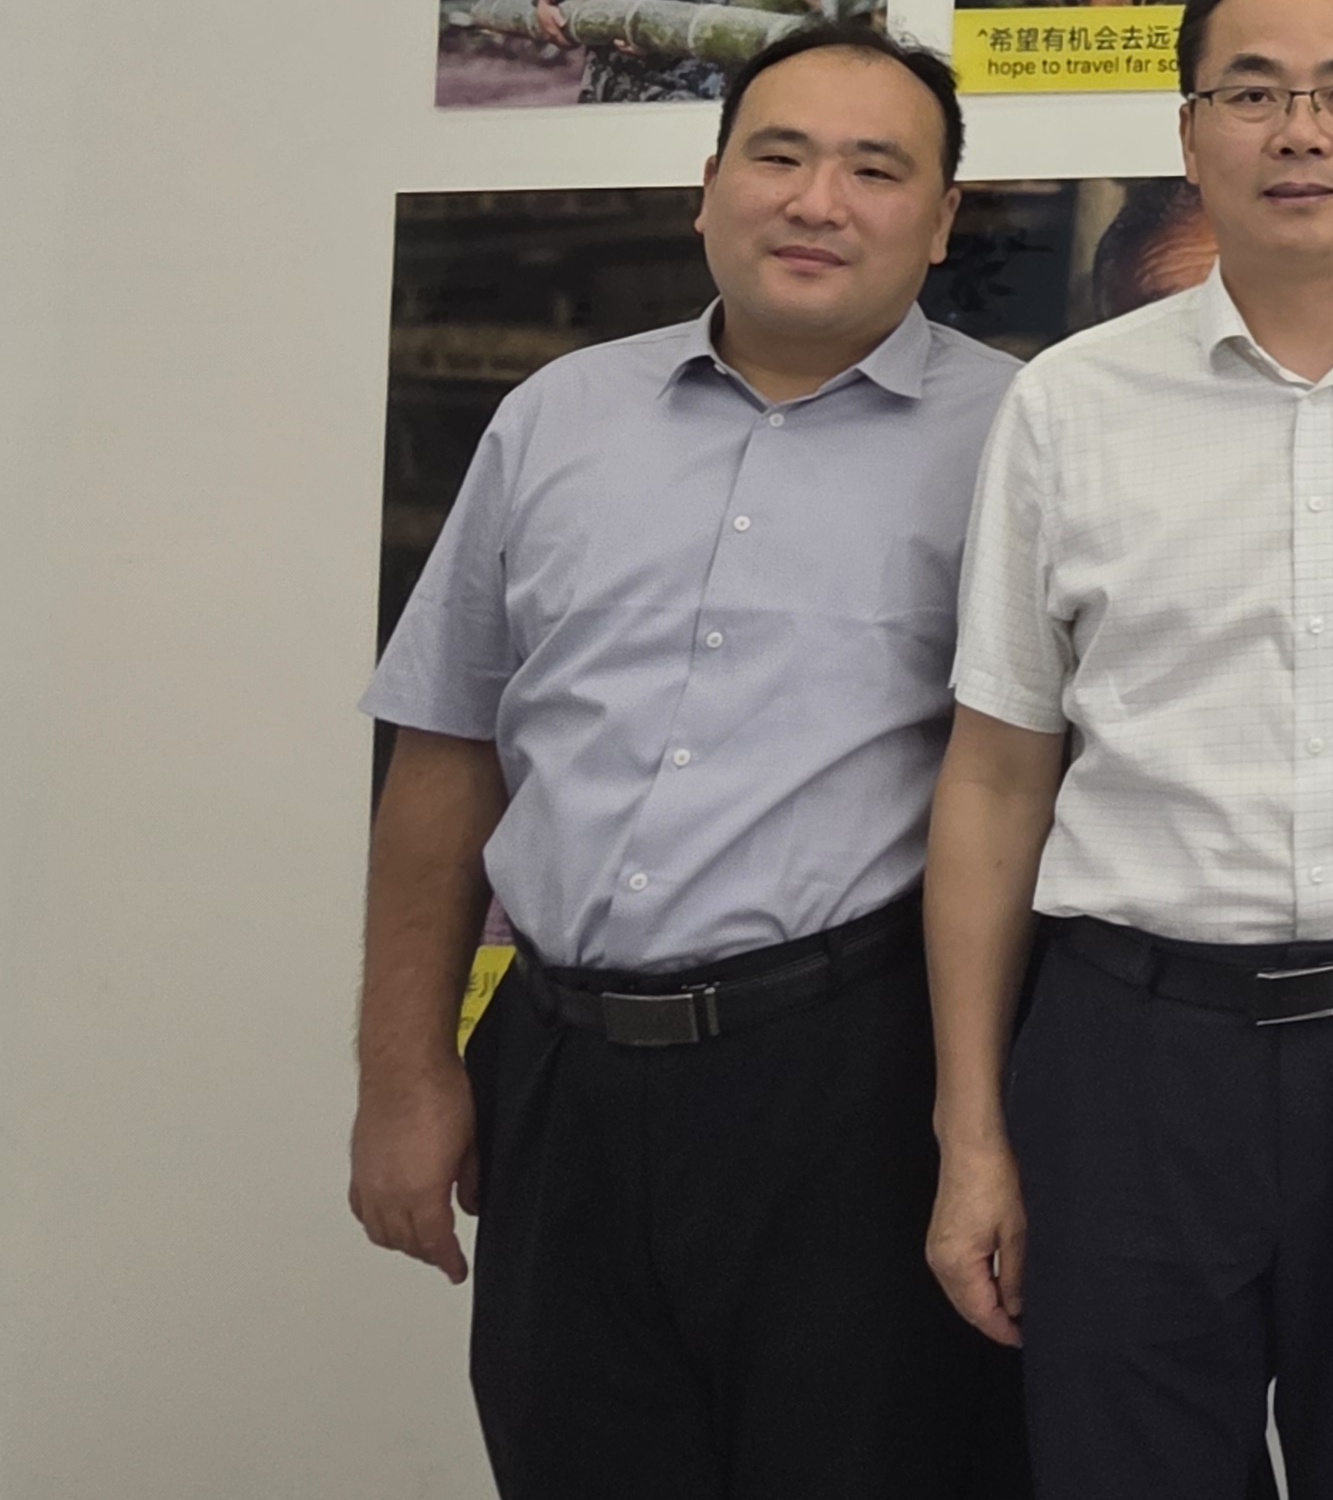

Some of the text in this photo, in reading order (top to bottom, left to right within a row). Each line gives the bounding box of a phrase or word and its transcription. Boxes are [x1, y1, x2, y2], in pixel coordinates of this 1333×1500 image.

[987, 58, 1035, 78] hope
[1042, 59, 1060, 75] to
[1066, 56, 1119, 75] travel
[1126, 55, 1150, 73] far
